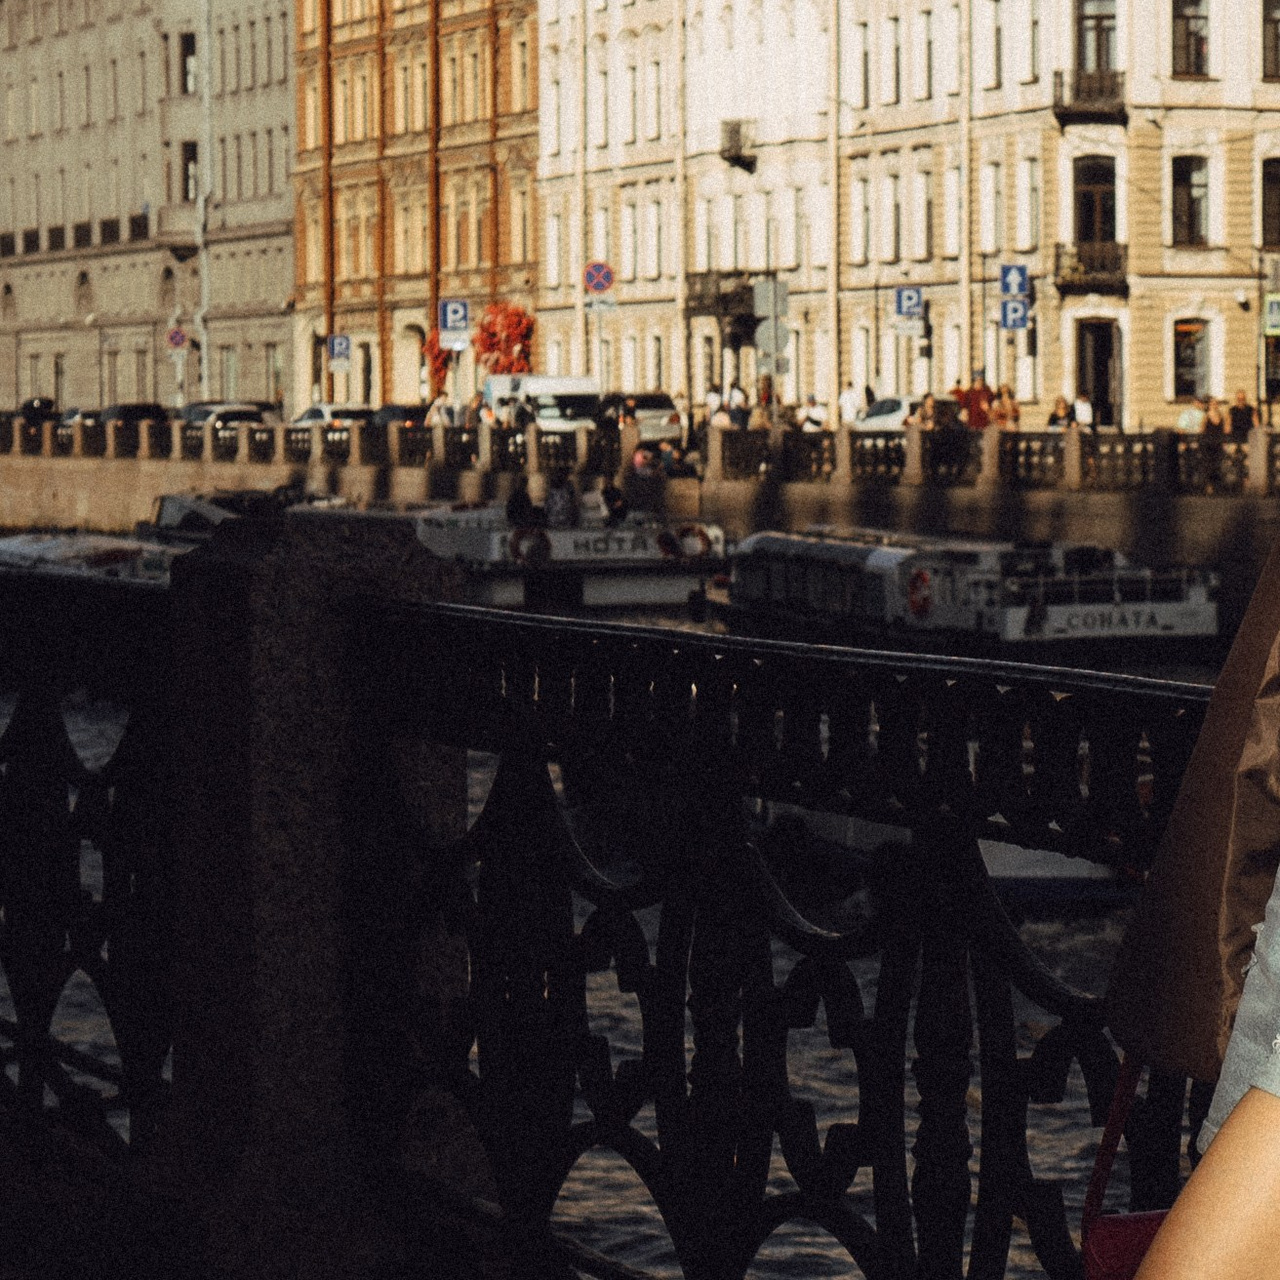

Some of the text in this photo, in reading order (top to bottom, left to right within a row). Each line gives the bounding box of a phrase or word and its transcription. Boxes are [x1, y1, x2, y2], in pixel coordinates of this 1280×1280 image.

[902, 289, 919, 315] P
[1006, 300, 1024, 327] P
[447, 302, 465, 330] P
[573, 535, 649, 553] НОТА
[1067, 610, 1159, 629] СОНАТА
